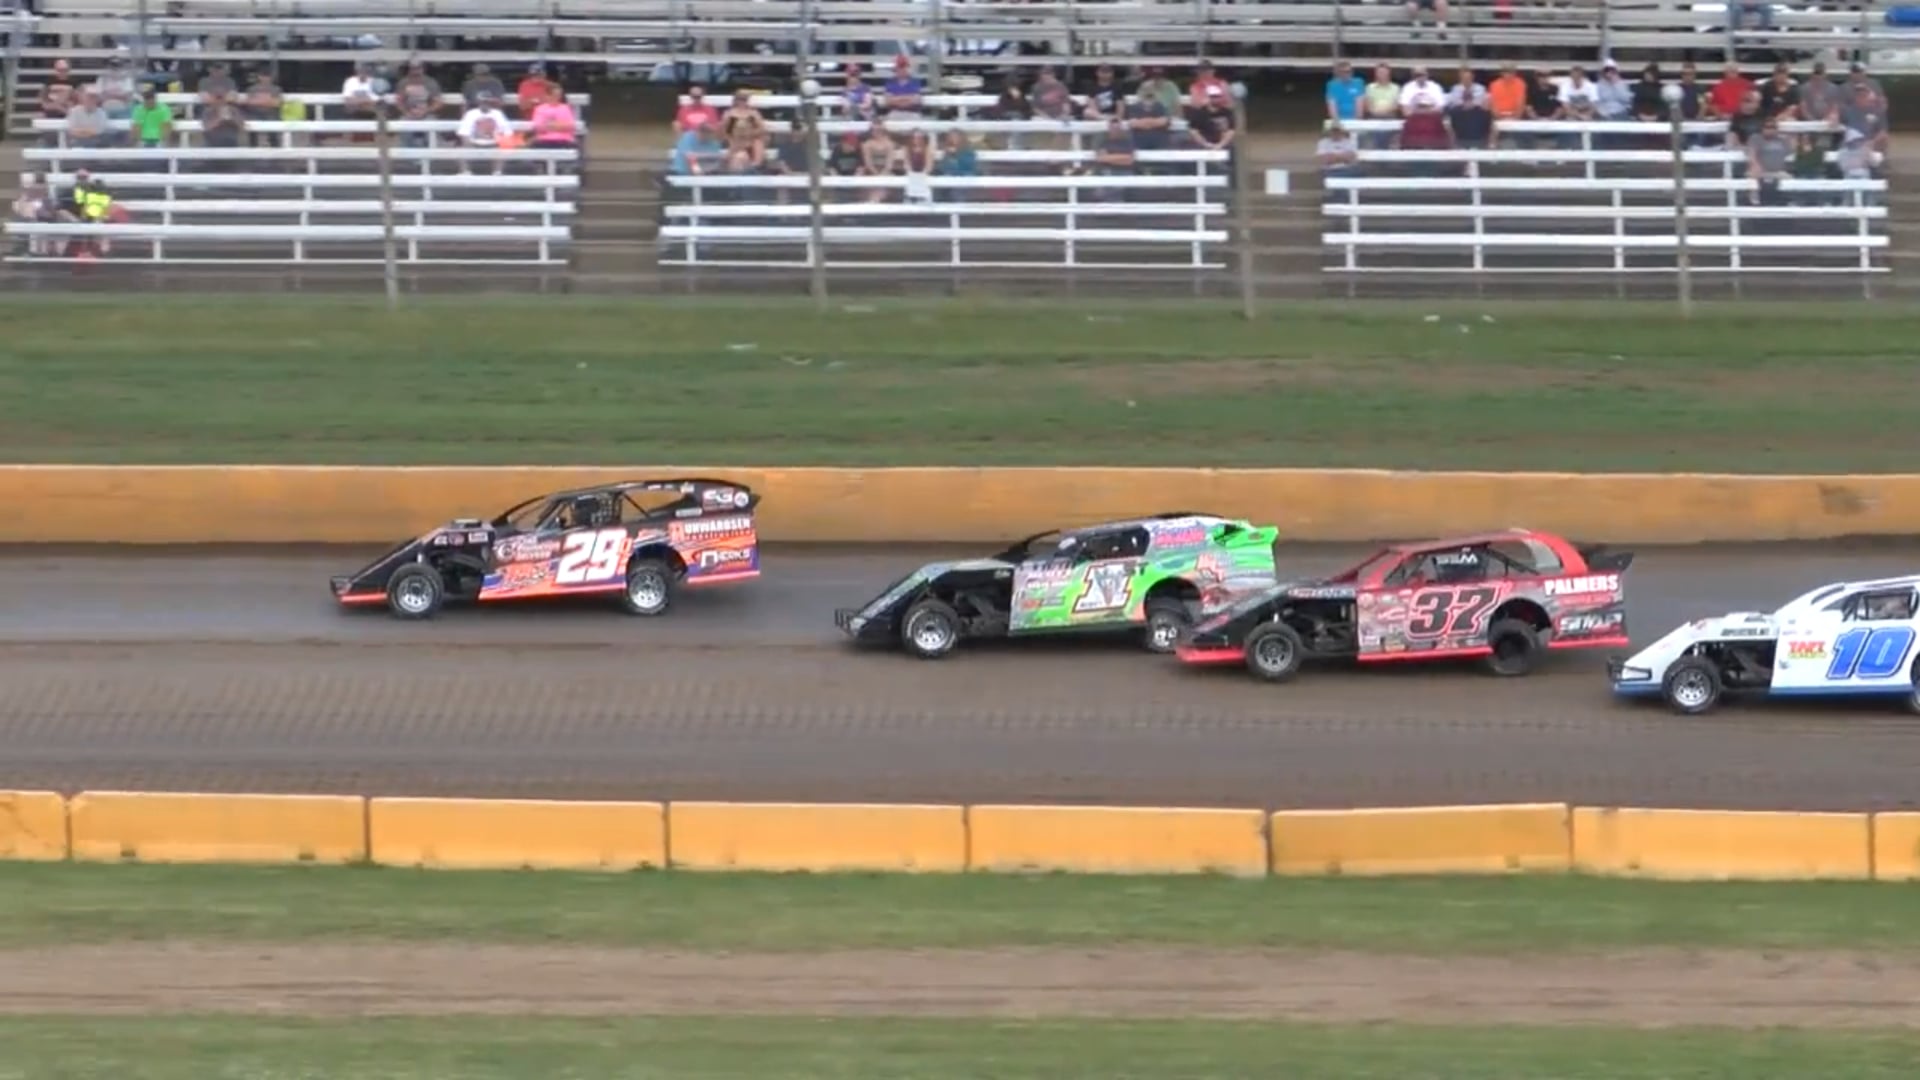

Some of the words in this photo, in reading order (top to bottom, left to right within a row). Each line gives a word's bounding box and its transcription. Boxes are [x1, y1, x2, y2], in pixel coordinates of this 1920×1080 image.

[556, 529, 627, 583] 29
[1544, 575, 1619, 595] PALMERS
[1407, 587, 1499, 640] 37
[1826, 627, 1916, 679] 10
